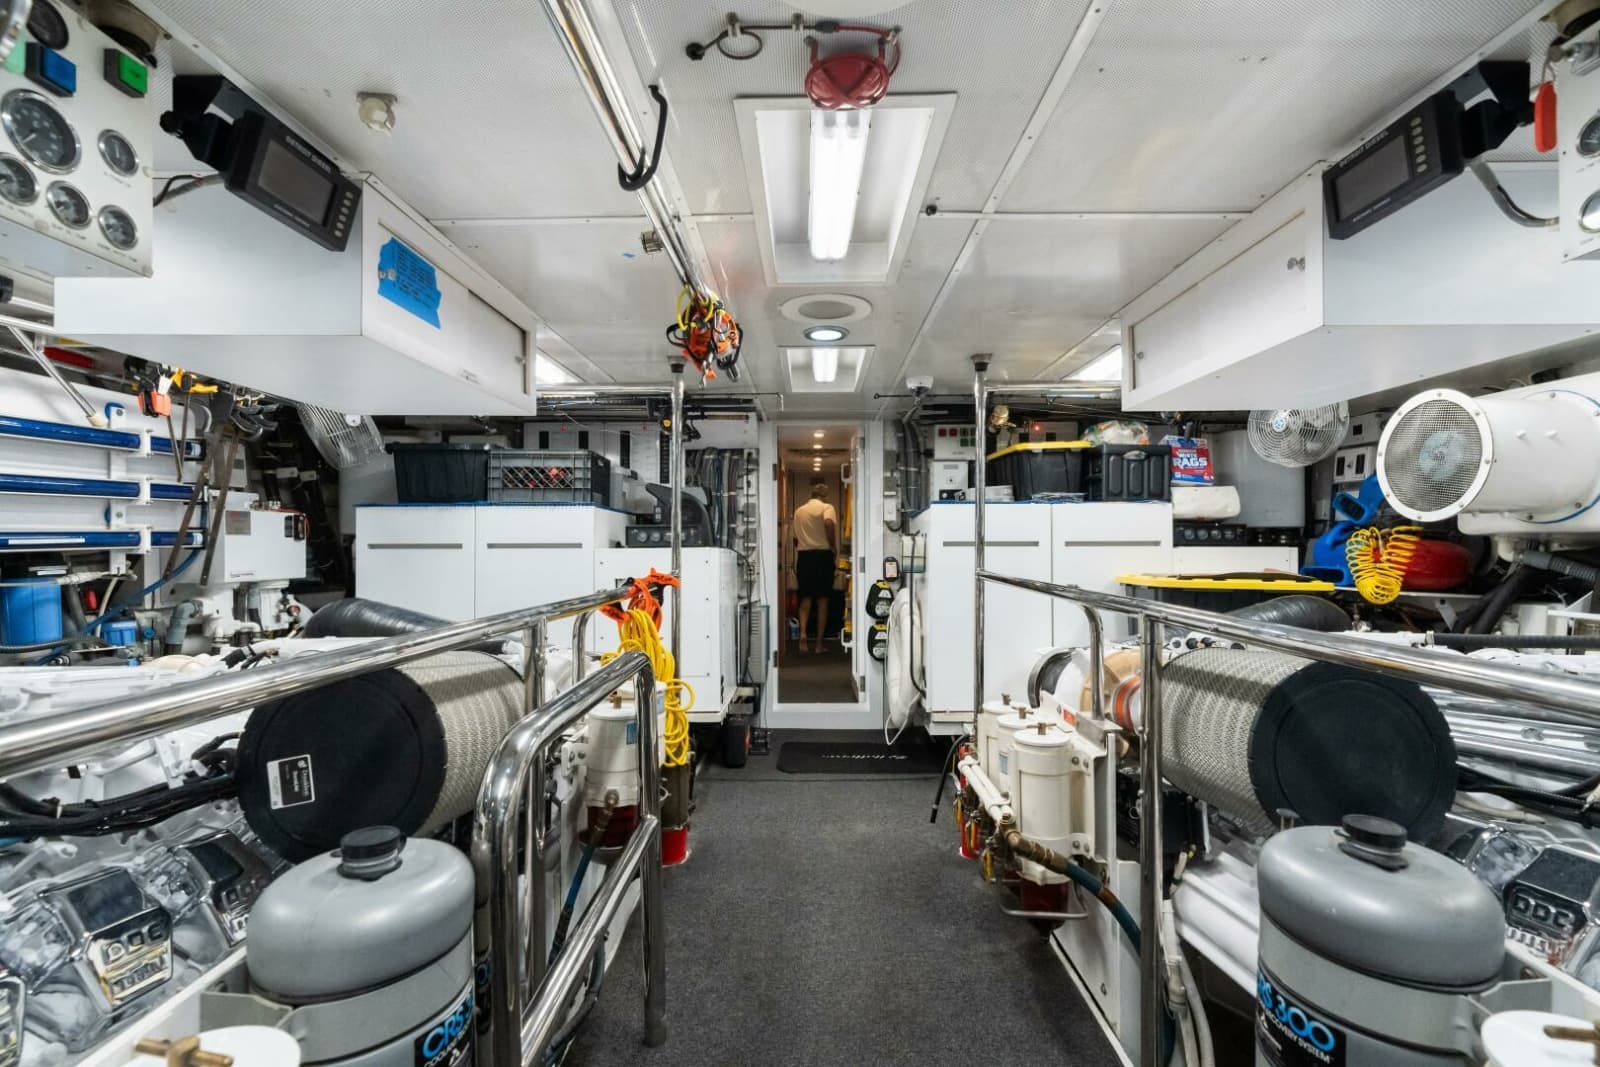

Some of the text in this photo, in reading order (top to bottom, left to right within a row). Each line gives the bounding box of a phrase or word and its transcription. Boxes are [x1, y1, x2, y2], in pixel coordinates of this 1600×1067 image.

[1172, 456, 1208, 470] RAGS
[422, 1005, 464, 1059] CRS
[1274, 994, 1336, 1053] 300
[1297, 1037, 1332, 1065] SYSTEM
